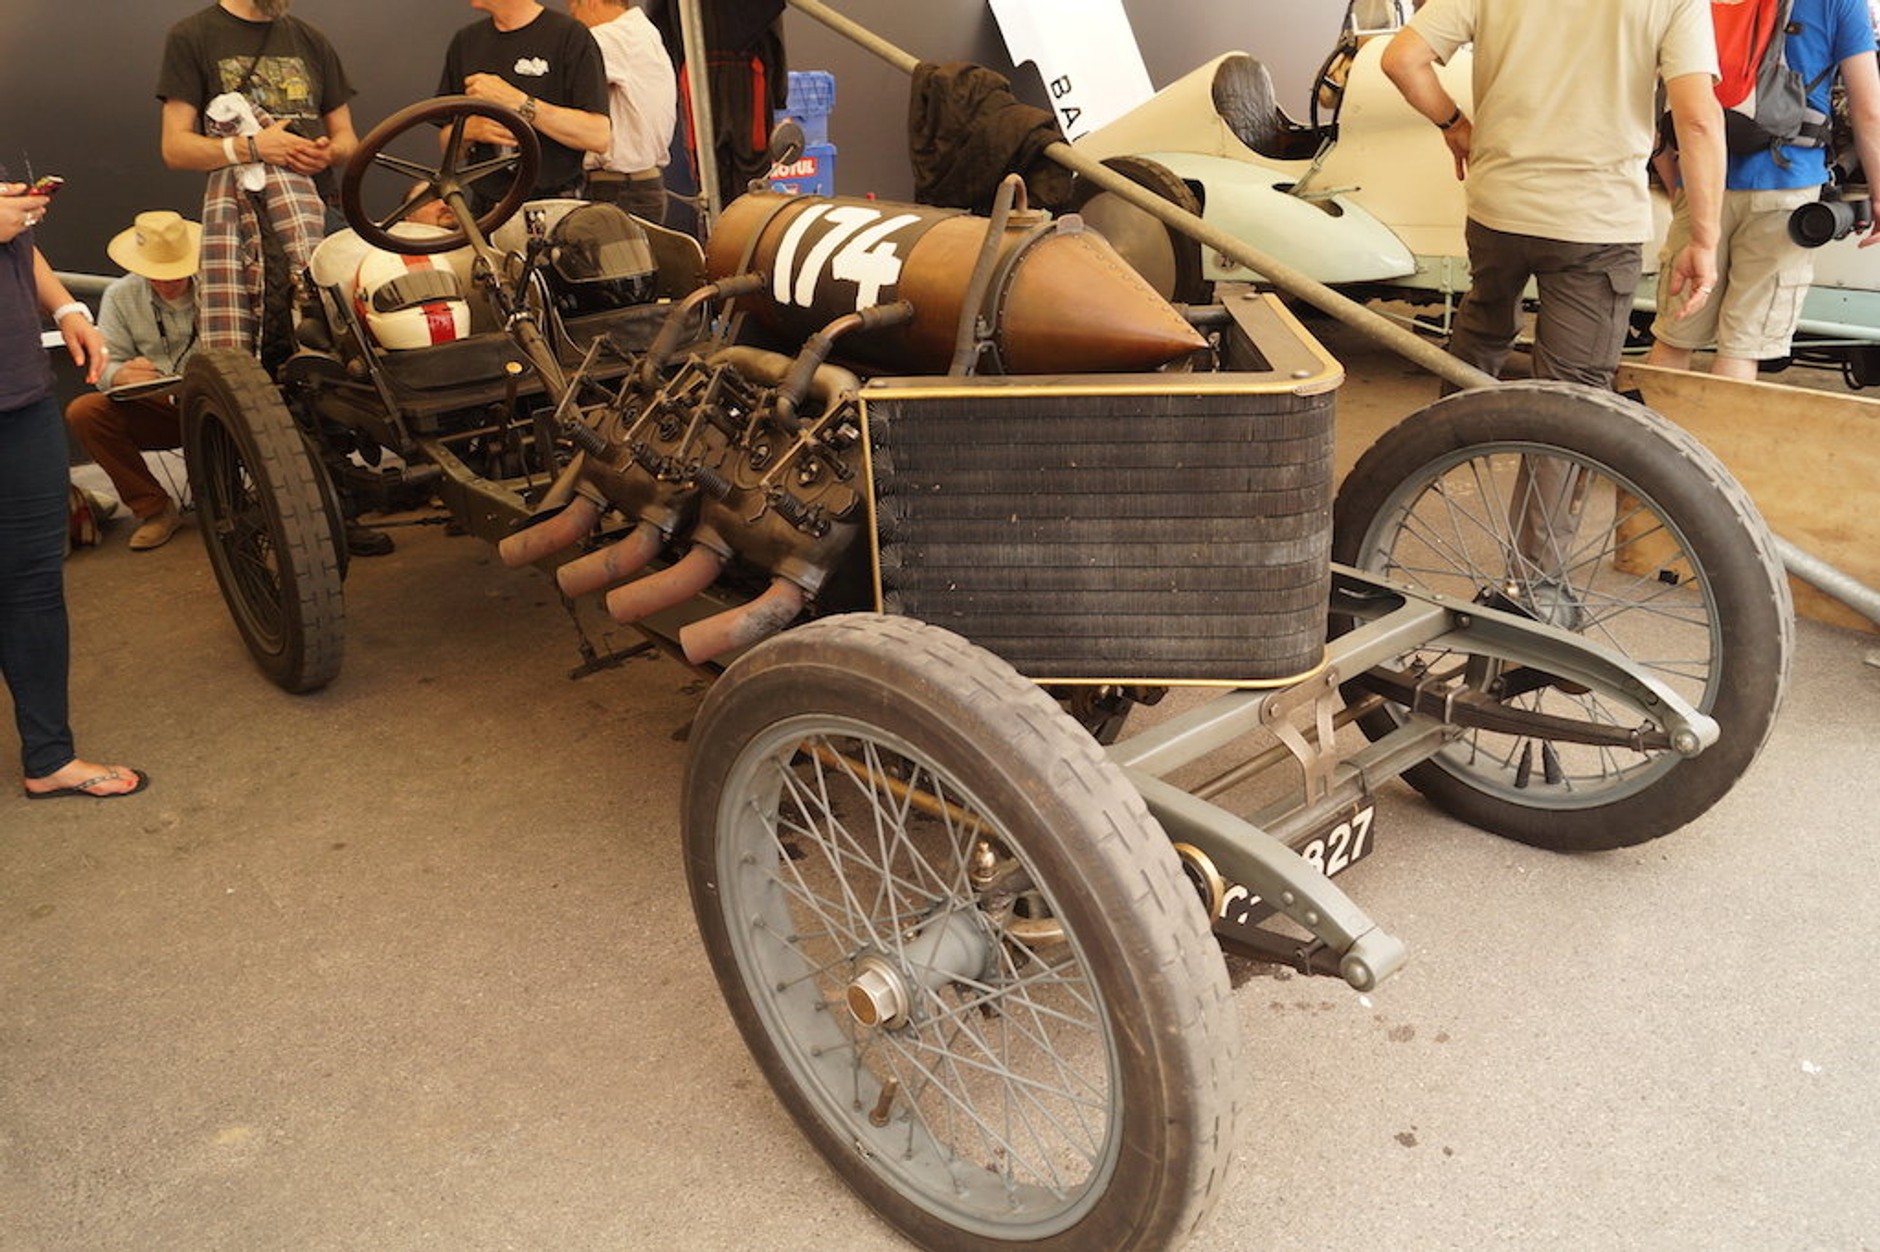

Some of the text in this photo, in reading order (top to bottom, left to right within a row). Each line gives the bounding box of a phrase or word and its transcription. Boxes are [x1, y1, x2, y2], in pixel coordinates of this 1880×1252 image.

[1050, 74, 1090, 143] BA
[773, 203, 922, 312] 174
[1301, 806, 1374, 877] 827
